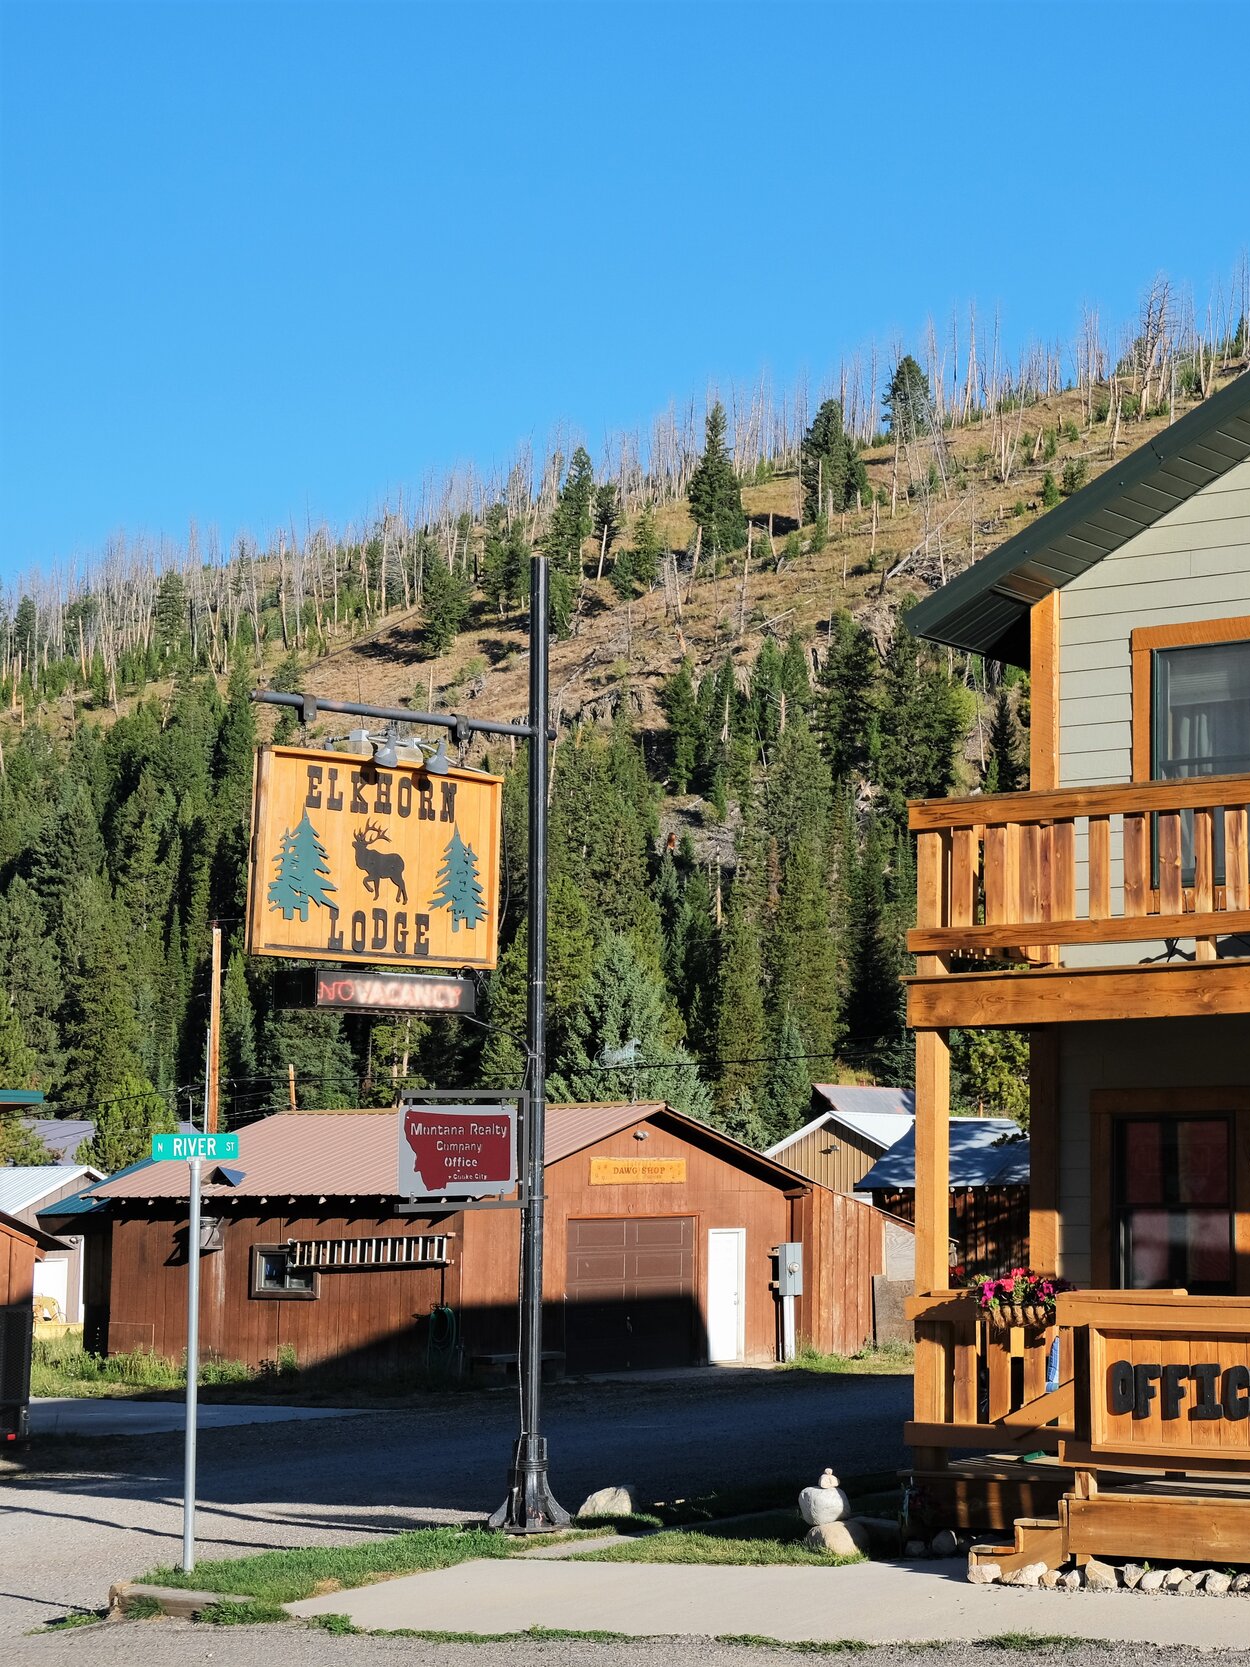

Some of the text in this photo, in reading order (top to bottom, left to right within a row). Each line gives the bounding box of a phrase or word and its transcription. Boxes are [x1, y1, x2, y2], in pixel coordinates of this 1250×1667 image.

[305, 764, 458, 824] ELKHORN
[327, 907, 431, 956] LODGE
[317, 979, 463, 1009] NO VACANCY
[410, 1122, 508, 1139] Montana Realty
[158, 1137, 235, 1157] N RIVER ST
[436, 1140, 482, 1154] Company
[444, 1156, 478, 1167] Office
[474, 1173, 488, 1181] City
[613, 1166, 666, 1175] DAWG SHOP
